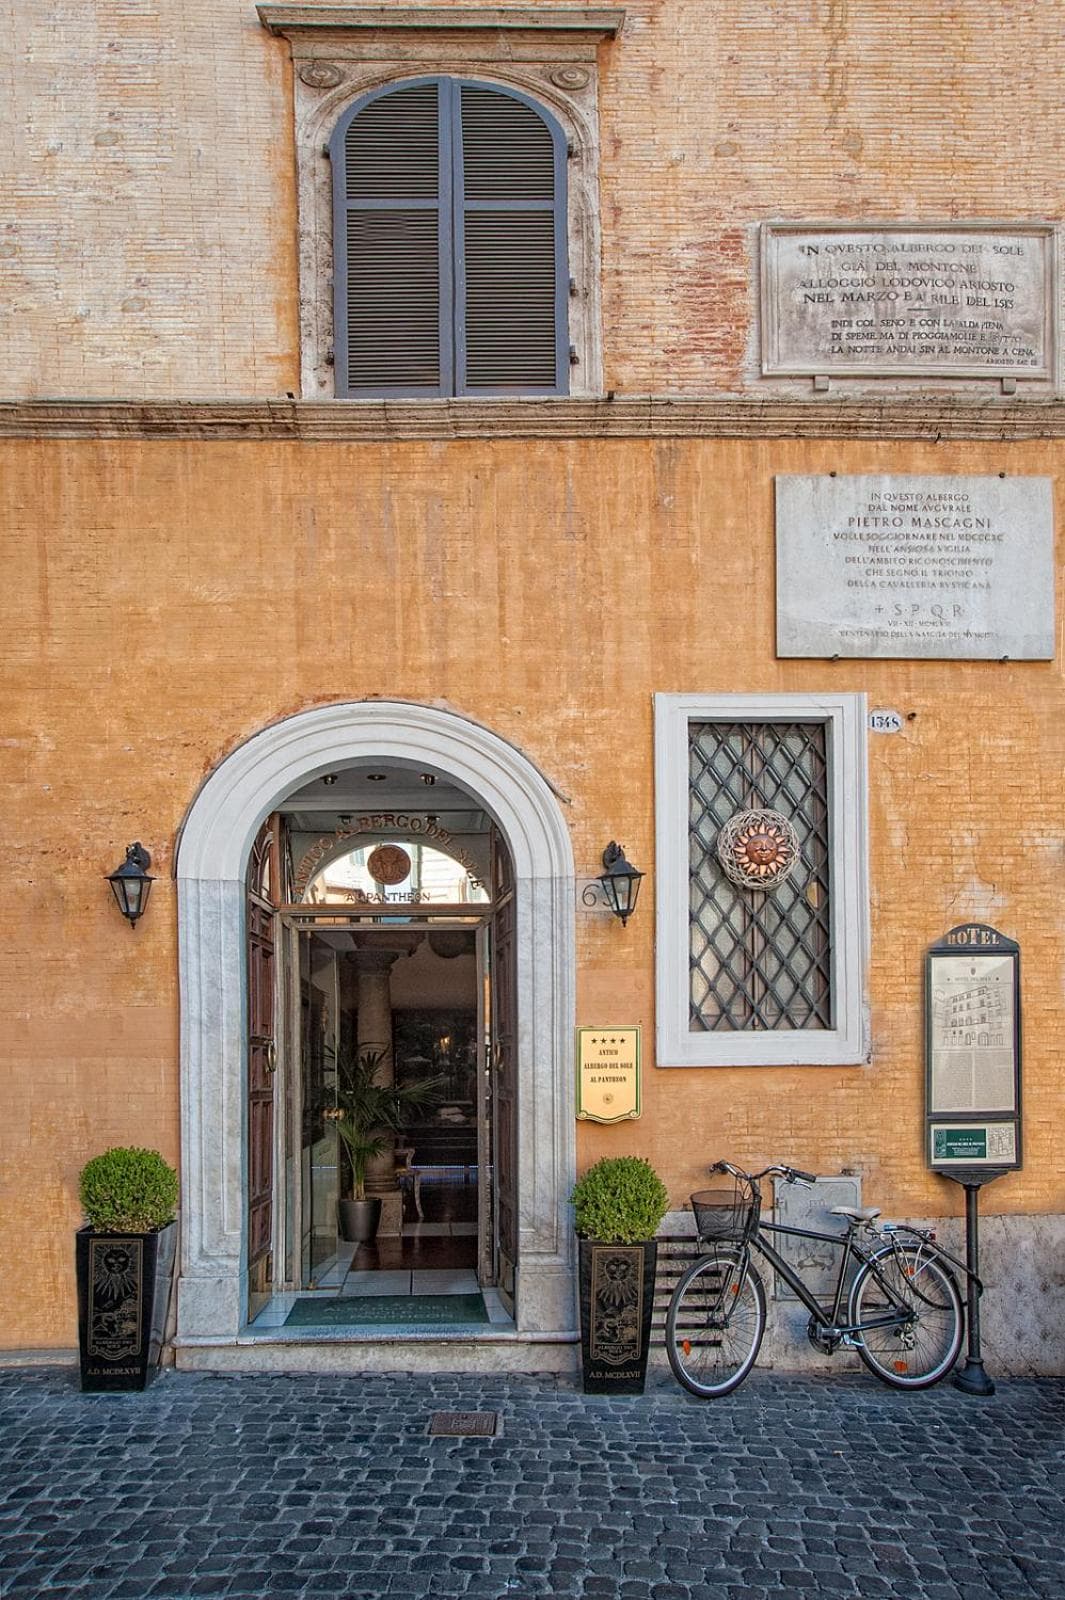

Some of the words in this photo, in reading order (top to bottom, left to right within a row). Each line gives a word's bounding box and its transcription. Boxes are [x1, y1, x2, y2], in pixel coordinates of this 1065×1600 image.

[890, 243, 956, 254] ALBERGO
[992, 245, 1025, 257] SOLE
[876, 261, 900, 271] DEL
[908, 262, 977, 274] MONTONE
[882, 277, 956, 289] LODOVICO
[960, 280, 1015, 293] ARIOSTO
[803, 293, 835, 304] NEL
[841, 291, 899, 303] MARZO
[904, 291, 913, 302] E
[966, 296, 991, 308] DEL
[856, 319, 876, 328] COL
[880, 319, 906, 328] SENO
[909, 319, 917, 328] E
[920, 319, 941, 328] CON
[831, 332, 842, 341] DI
[880, 332, 895, 341] MA
[898, 332, 908, 341] DI
[912, 332, 948, 342] PIOGGIA
[831, 346, 844, 355] LA
[847, 346, 881, 355] NOTTE
[920, 346, 935, 355] SIN
[939, 347, 949, 356] AL
[954, 347, 1000, 357] MONTONE
[1002, 348, 1009, 357] A
[871, 492, 881, 501] IN
[884, 492, 923, 502] QVESTO
[926, 493, 969, 502] ALBERGO
[868, 503, 888, 512] DAL
[891, 503, 919, 512] NOME
[922, 504, 972, 513] AVGVRALE
[848, 516, 904, 528] PIETRO
[911, 517, 991, 529] MASCAGNI
[865, 568, 884, 577] CHE
[921, 569, 929, 578] IL
[366, 892, 431, 903] PANTHEON
[947, 927, 1000, 945] HOTEL
